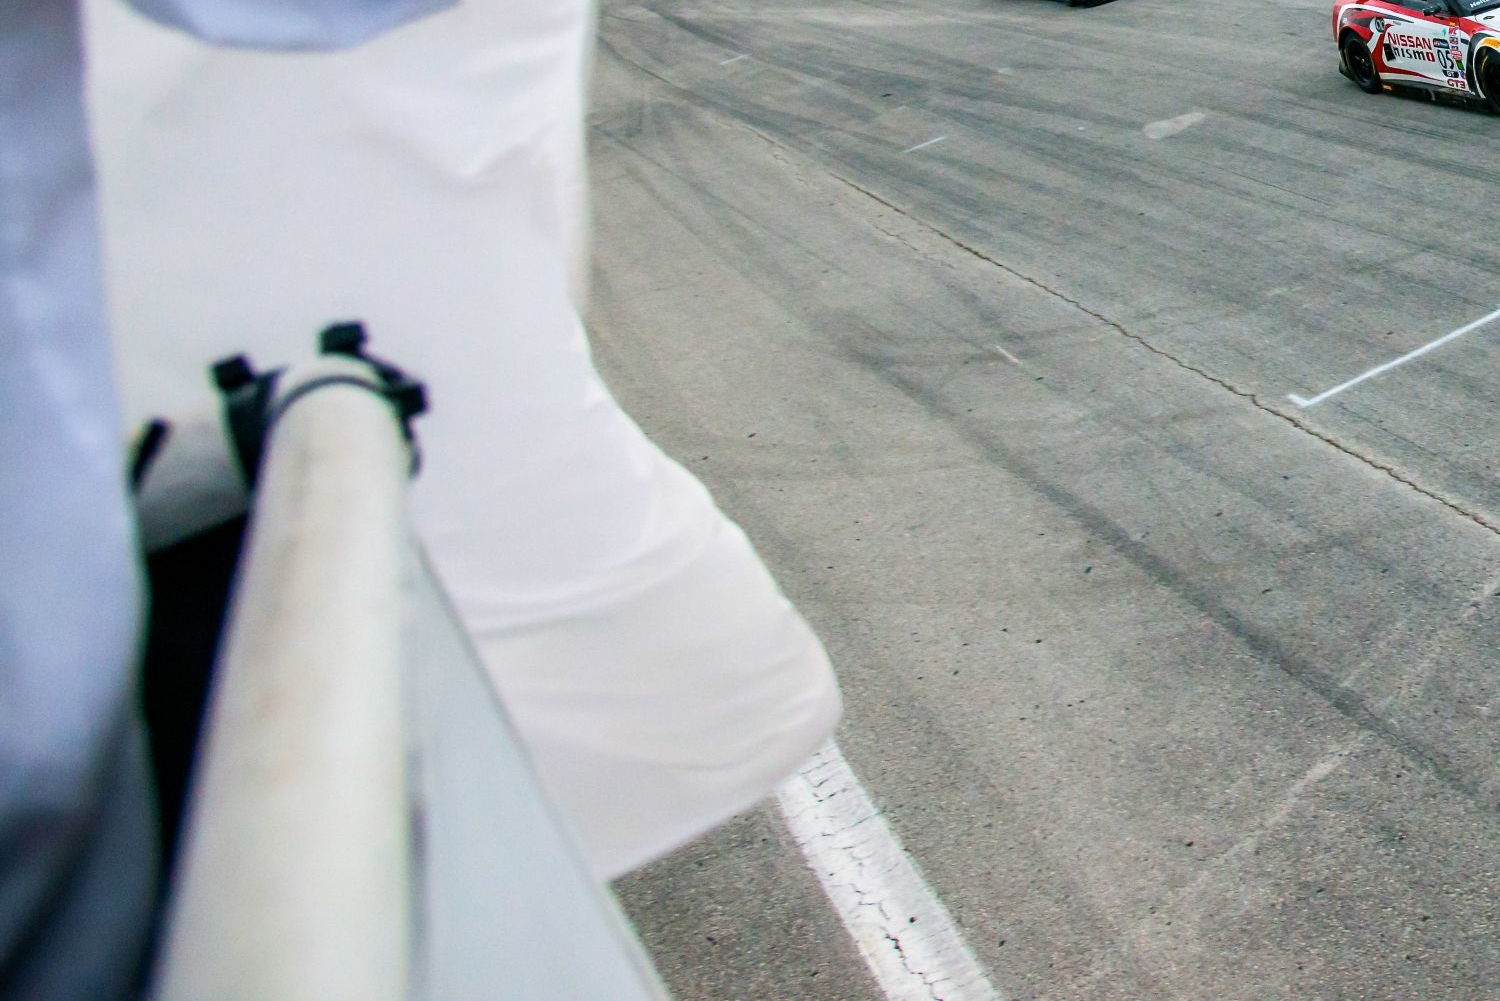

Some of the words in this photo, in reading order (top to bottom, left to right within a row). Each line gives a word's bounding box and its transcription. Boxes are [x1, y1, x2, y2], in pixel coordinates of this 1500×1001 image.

[1387, 32, 1432, 51] NISSAN
[1392, 46, 1436, 63] nismo
[1437, 49, 1455, 70] 05
[1446, 78, 1467, 90] GT3
